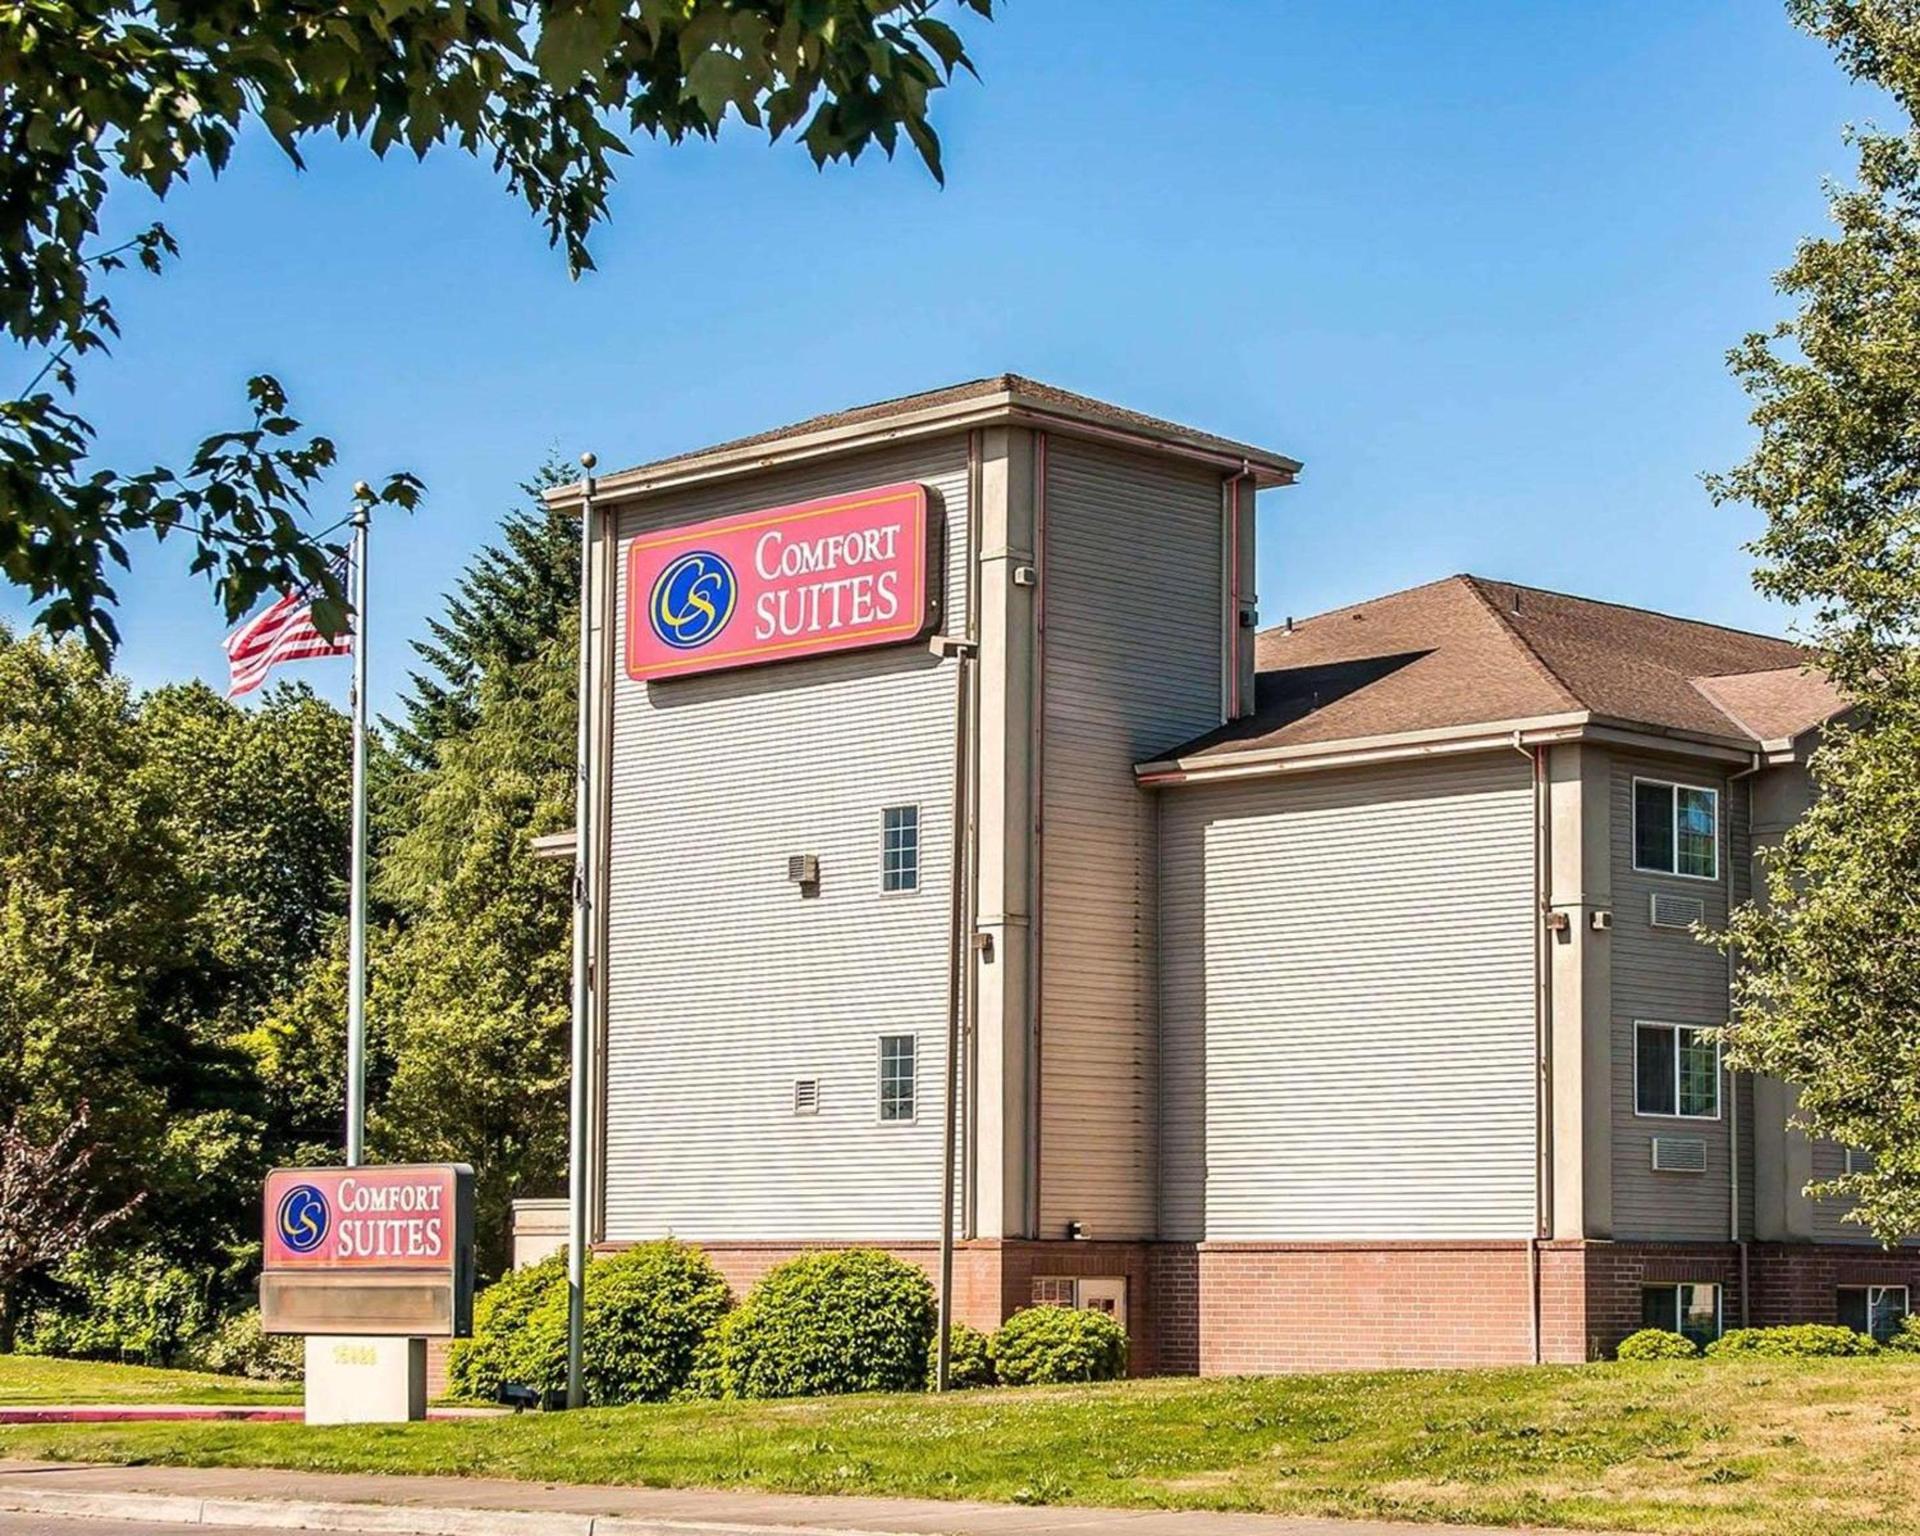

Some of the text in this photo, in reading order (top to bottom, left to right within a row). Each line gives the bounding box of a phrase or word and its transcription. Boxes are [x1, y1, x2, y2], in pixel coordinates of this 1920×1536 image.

[755, 525, 900, 580] COMFORT
[755, 570, 898, 640] SUITES
[337, 1178, 442, 1212] COMFORT
[337, 1217, 442, 1257] SUITES
